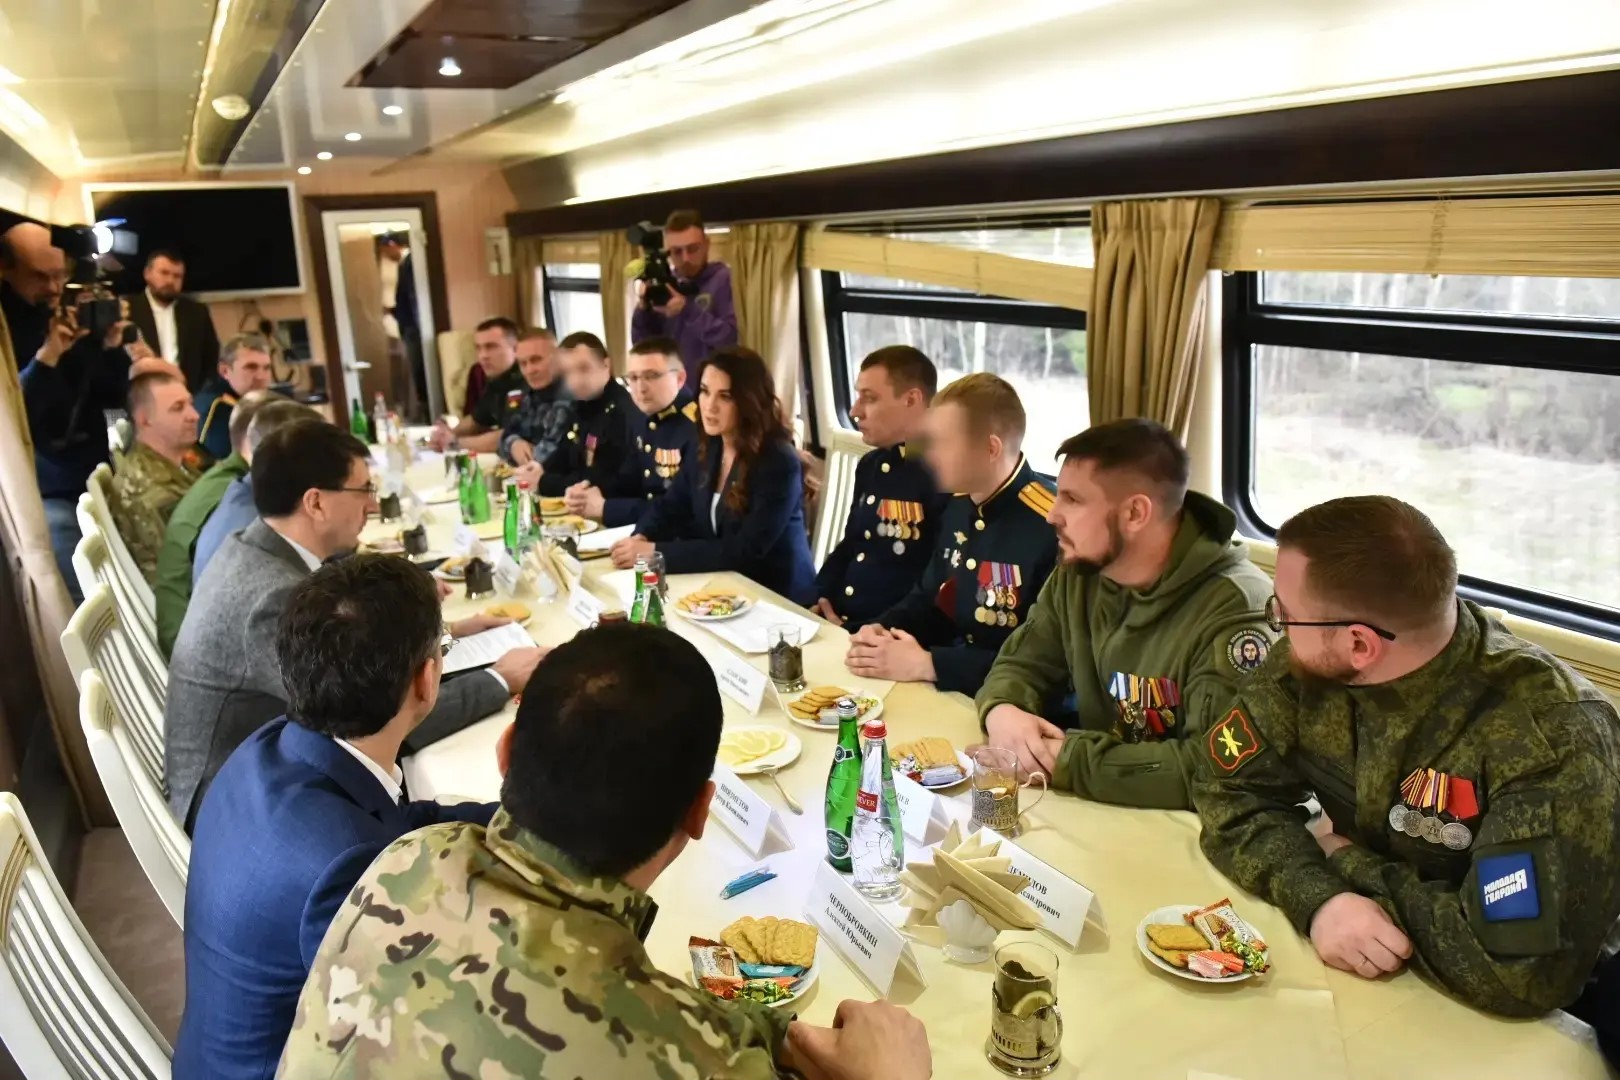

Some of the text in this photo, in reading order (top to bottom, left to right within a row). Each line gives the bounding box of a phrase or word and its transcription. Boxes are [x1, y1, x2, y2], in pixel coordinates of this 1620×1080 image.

[824, 906, 872, 959] Алексей Юрьевич
[829, 892, 878, 948] ЧЕРНОБРОВКИН
